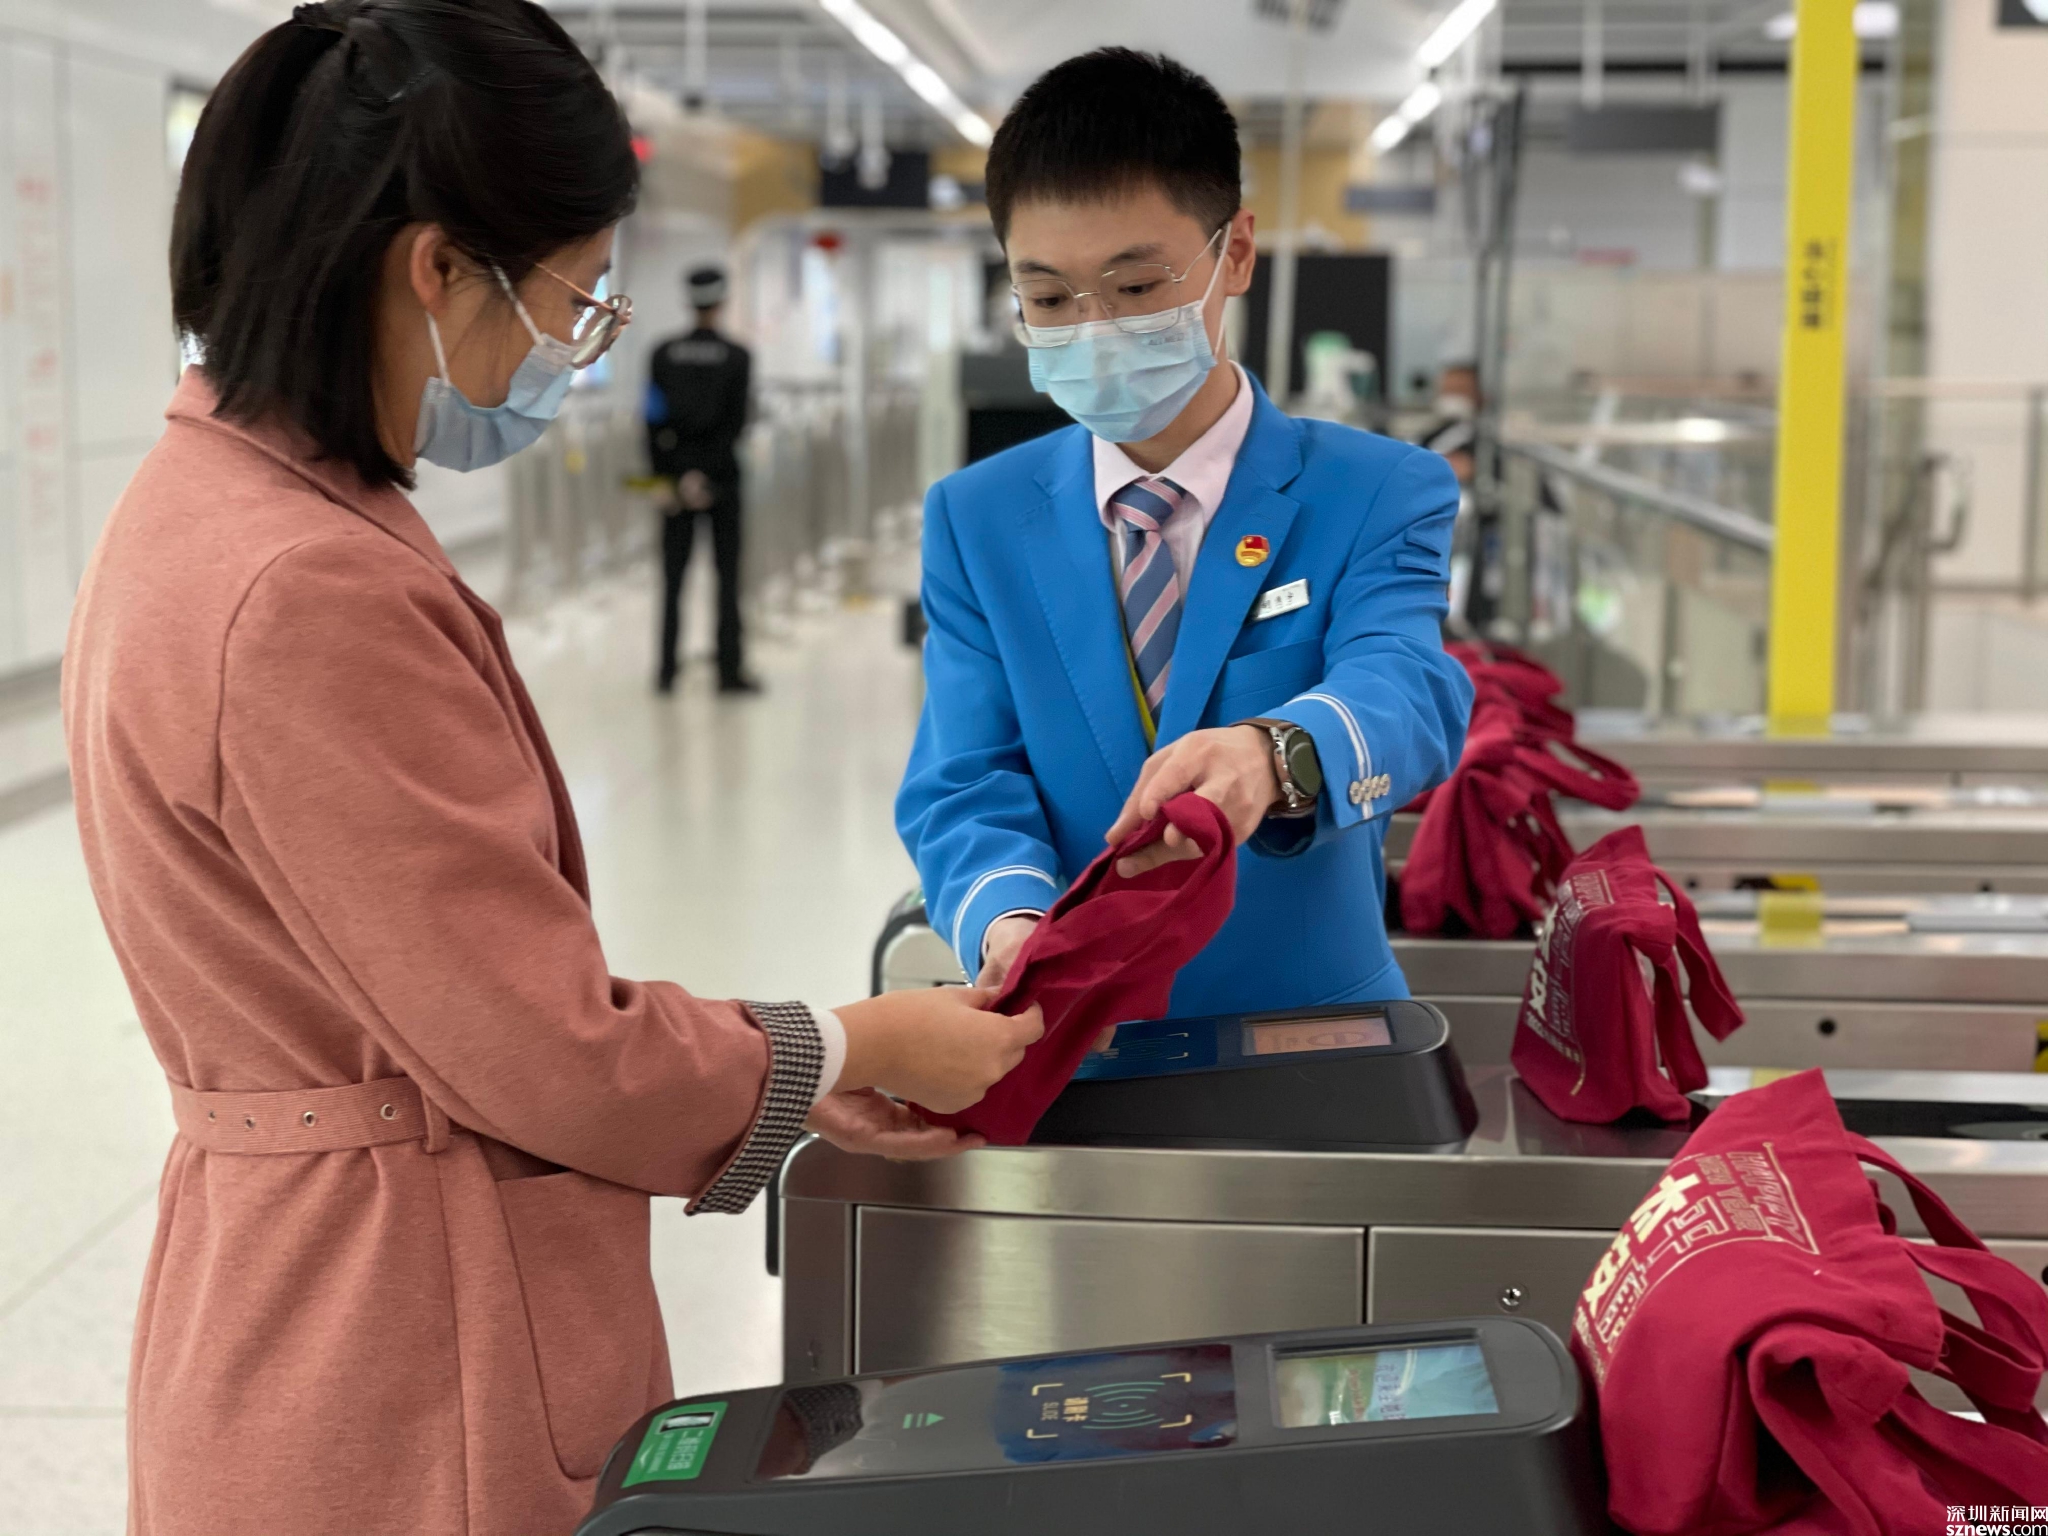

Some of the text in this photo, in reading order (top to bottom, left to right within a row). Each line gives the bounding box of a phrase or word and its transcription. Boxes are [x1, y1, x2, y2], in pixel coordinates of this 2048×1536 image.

[1695, 1153, 1766, 1232] NEW YEAR
[1726, 1151, 1806, 1245] HAPPY
